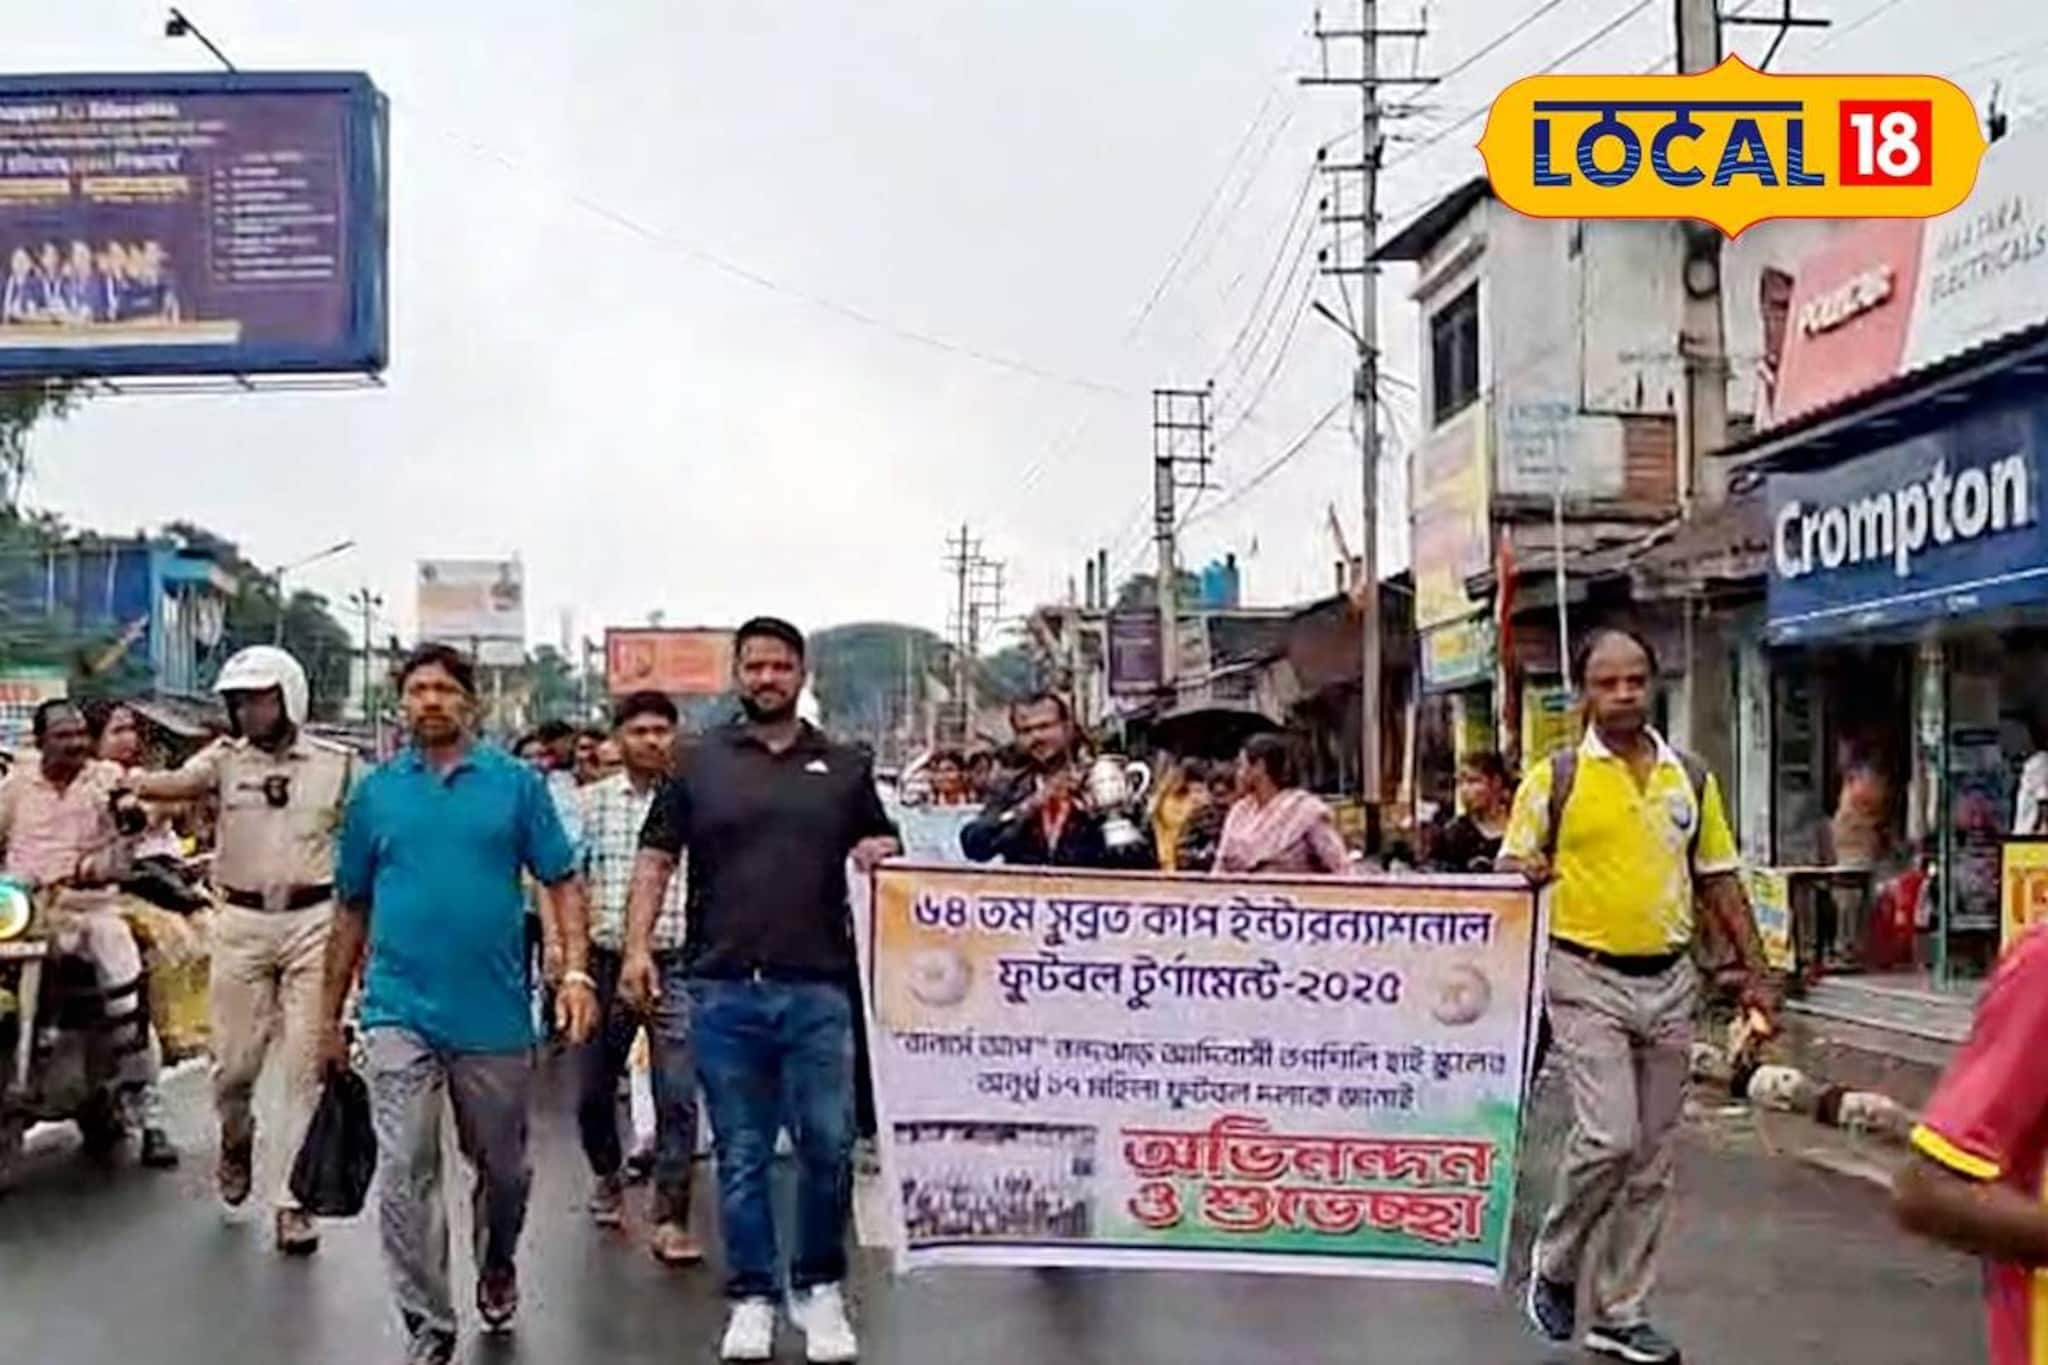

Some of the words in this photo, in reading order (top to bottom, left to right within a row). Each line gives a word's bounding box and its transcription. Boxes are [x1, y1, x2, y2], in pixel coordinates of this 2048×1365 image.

[1774, 454, 2031, 580] Crompton
[915, 896, 967, 928] ৬৪
[978, 896, 1036, 931] তম
[1042, 899, 1131, 946] সুব্রত
[1142, 901, 1218, 938] কাপ
[1229, 896, 1492, 945] ইন্টারন্যাশনাল
[998, 951, 1122, 1005] ফুটবল
[1047, 1076, 1080, 1098] ১৭
[1087, 1071, 1160, 1101] মহিলা
[1166, 1074, 1250, 1110] ফুটবল
[1120, 1114, 1497, 1188] অভিনন্দন
[1128, 1181, 1183, 1228] ও
[1204, 1183, 1486, 1246] শুভেচ্ছা
